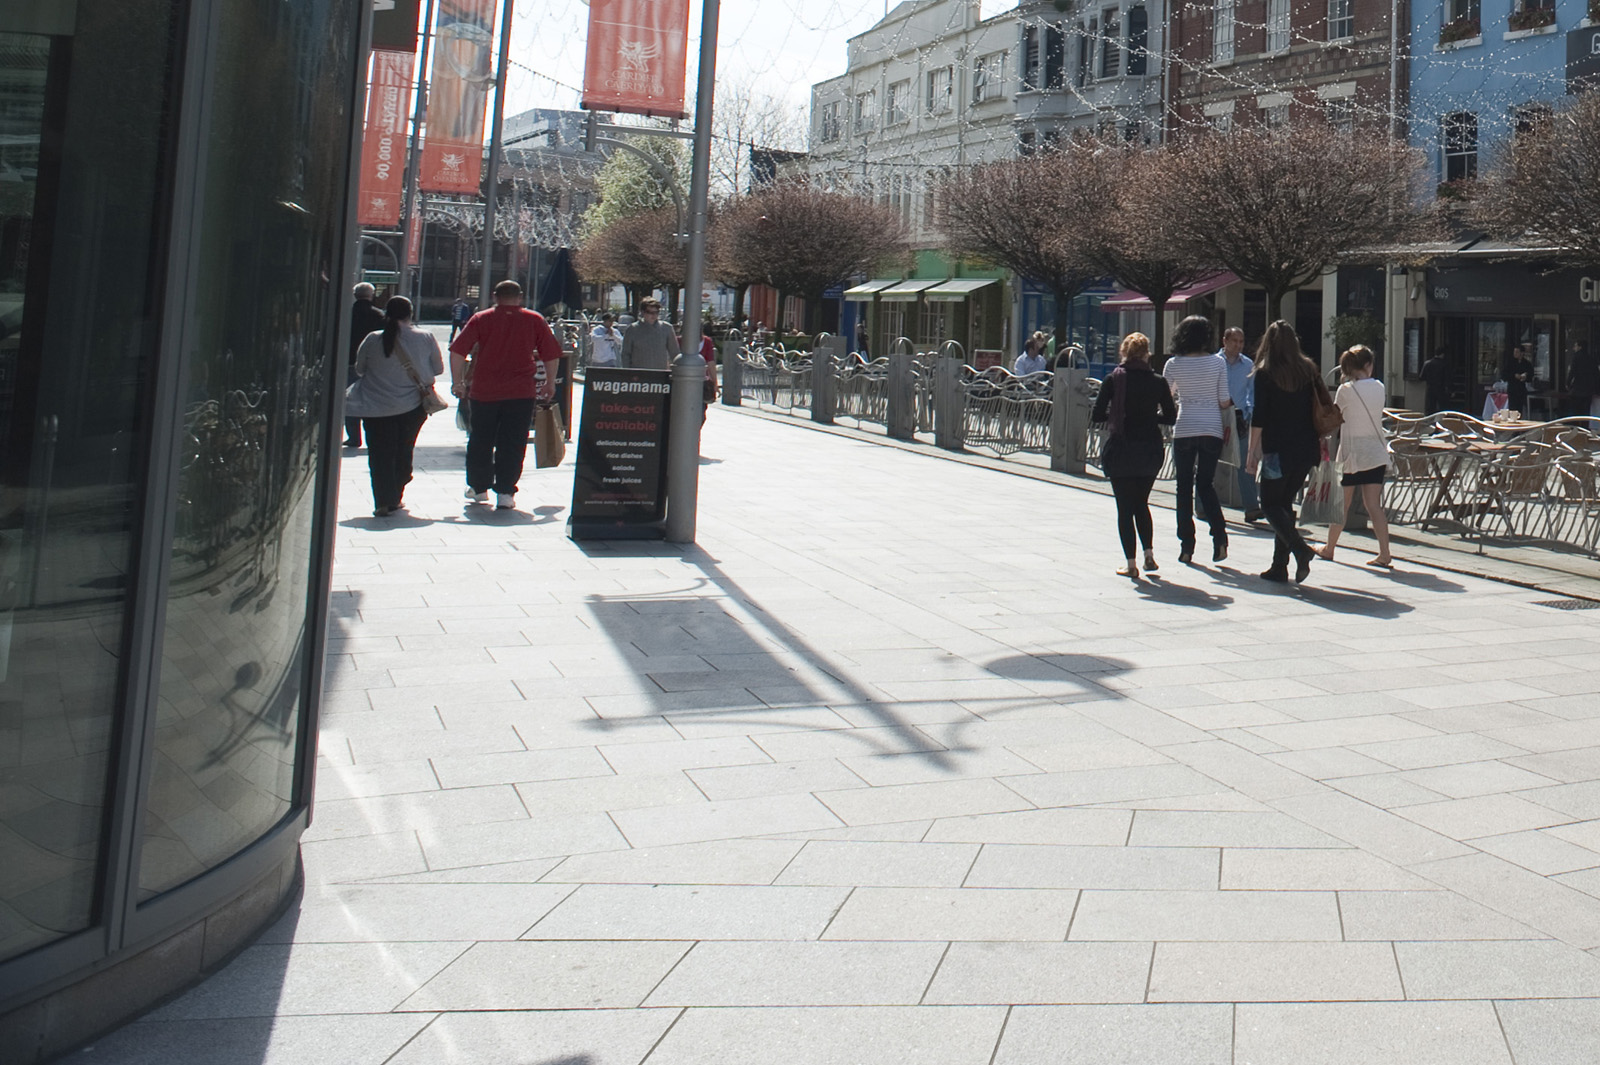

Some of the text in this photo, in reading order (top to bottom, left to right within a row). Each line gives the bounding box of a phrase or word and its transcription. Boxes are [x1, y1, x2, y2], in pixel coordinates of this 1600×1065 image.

[377, 138, 393, 180] 90,000
[592, 380, 671, 395] wagamama
[601, 403, 655, 414] take-out
[595, 420, 657, 432] available
[621, 477, 642, 485] juices
